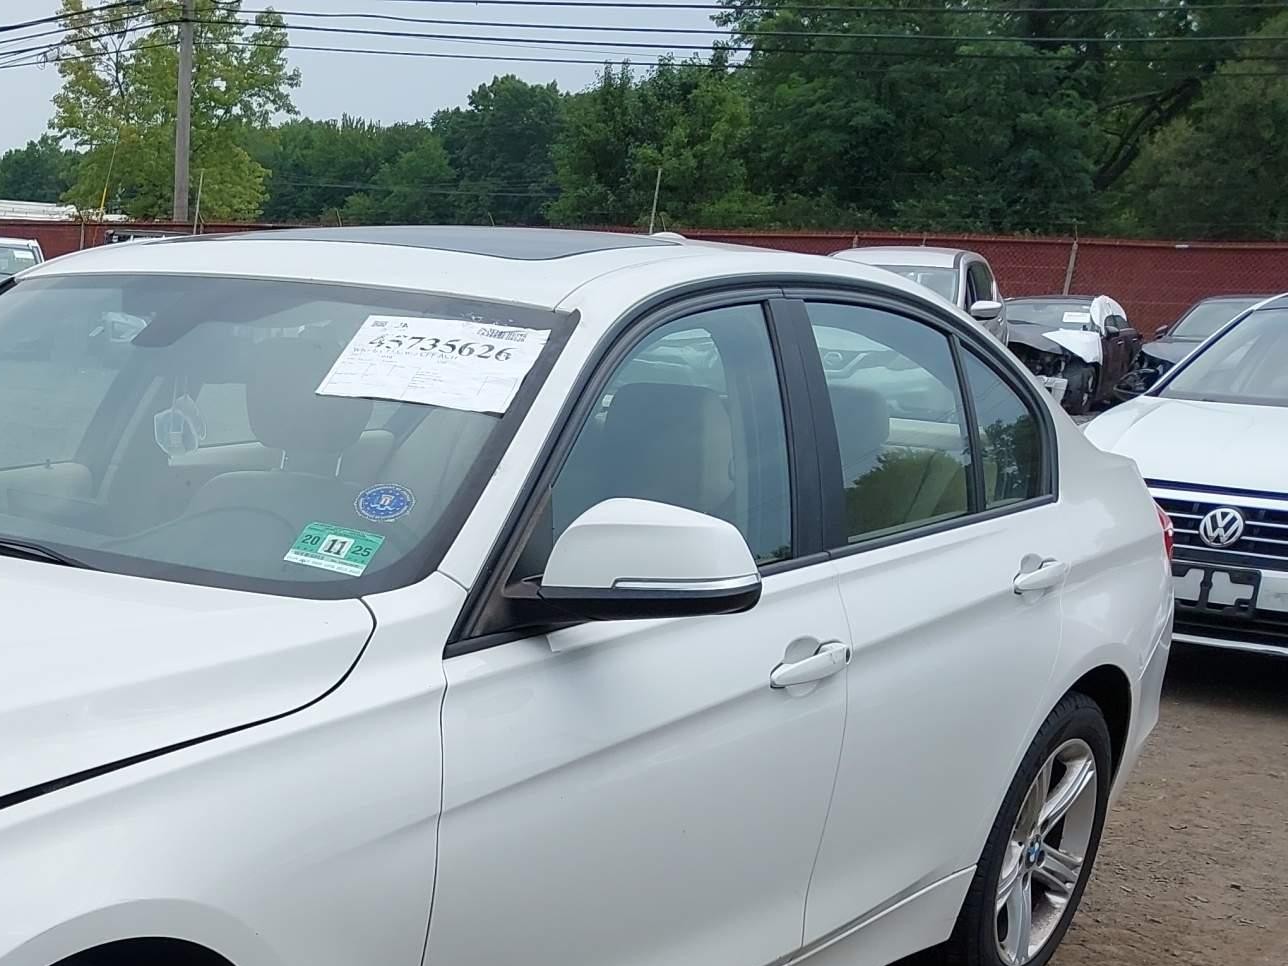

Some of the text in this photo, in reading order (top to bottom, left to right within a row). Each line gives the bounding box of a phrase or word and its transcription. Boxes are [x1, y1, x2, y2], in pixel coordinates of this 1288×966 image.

[368, 332, 520, 365] 45735626
[301, 534, 373, 557] 20 11 25
